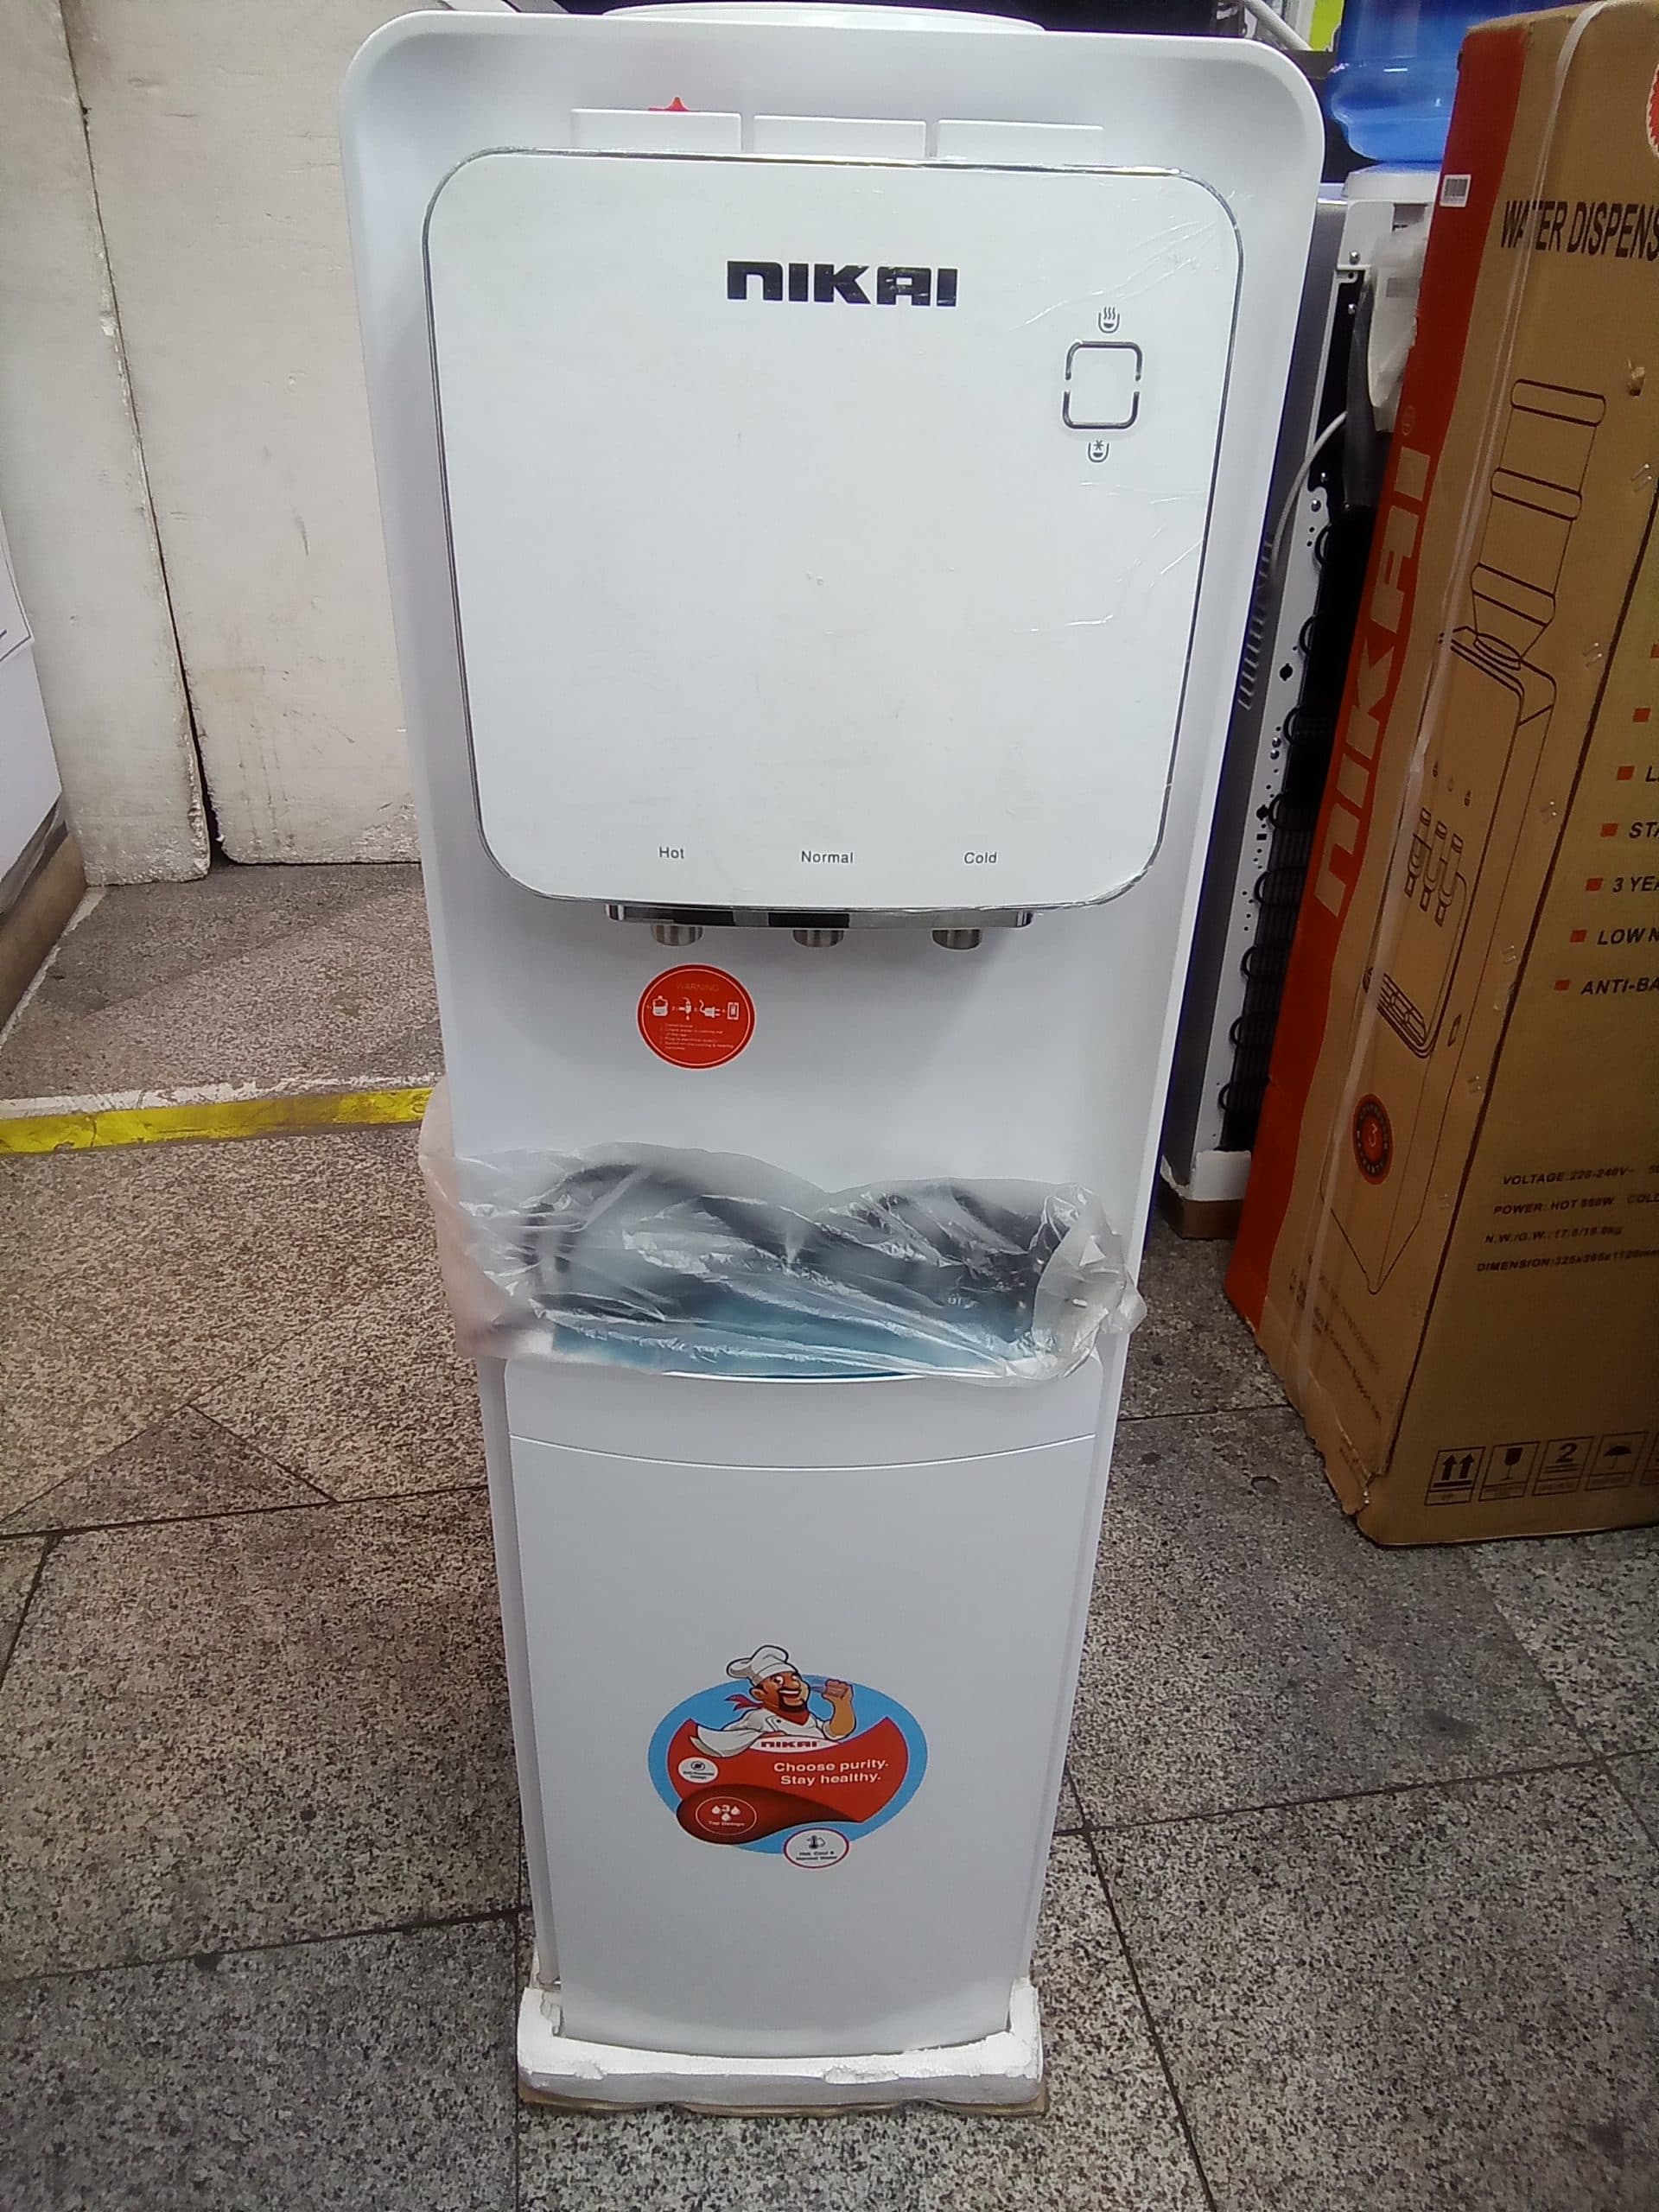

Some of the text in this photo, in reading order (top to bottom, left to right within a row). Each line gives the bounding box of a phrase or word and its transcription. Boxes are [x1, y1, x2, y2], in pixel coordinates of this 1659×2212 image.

[726, 259, 959, 308] NIKAI
[1314, 447, 1431, 918] NIKAI
[658, 846, 998, 865] Hot Normal Cold
[1612, 876, 1625, 893] 3
[1596, 927, 1646, 945] LOW
[1550, 1198, 1578, 1211] HOT
[1556, 1442, 1578, 1463] 2
[773, 1758, 889, 1772] Choose purity.
[780, 1772, 881, 1787] Stay healthy.
